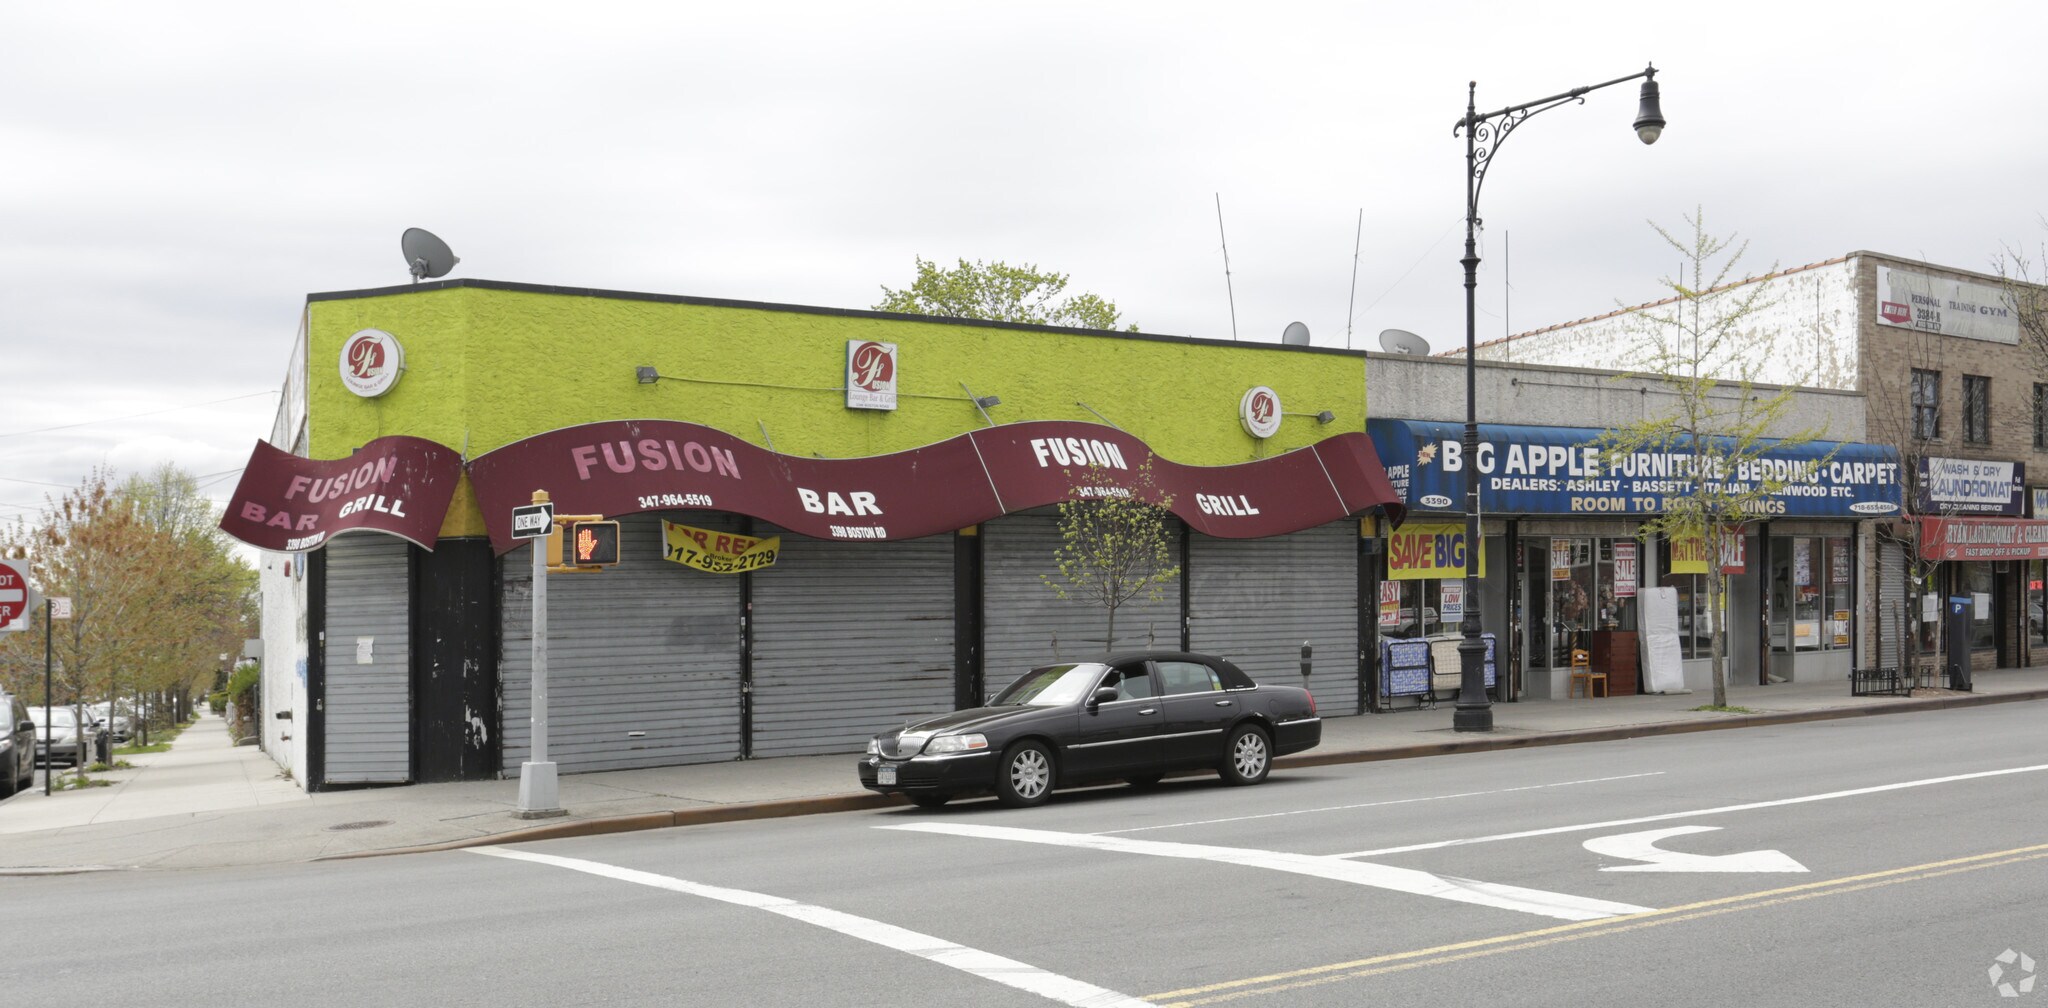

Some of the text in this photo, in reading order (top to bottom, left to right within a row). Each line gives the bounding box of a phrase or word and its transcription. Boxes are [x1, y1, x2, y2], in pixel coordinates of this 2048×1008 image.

[1912, 294, 1941, 307] PERSONAL
[1949, 300, 2008, 318] TRAINING GYM
[571, 439, 742, 480] FUSION
[1030, 437, 1129, 471] FUSION
[1443, 440, 1600, 478] BG APPLE
[1387, 464, 1410, 479] APPLE
[1610, 452, 1724, 479] FURNITURE
[1830, 461, 1897, 485] CARPET
[1943, 464, 2001, 477] WASH & DRY
[285, 456, 398, 504] FUSION
[1491, 477, 1561, 492] DEALERS:
[1566, 479, 1620, 492] ASHLEY
[1632, 480, 1691, 493] BASSETT
[1762, 484, 1827, 497] ENWOOD
[1831, 486, 1855, 498] ETC.
[1931, 479, 2012, 499] LAUNDROMAT
[338, 494, 406, 518] GRILL
[638, 493, 713, 509] 347-964-5519
[797, 487, 883, 516] BAR
[1195, 493, 1260, 517] GRILL
[1425, 497, 1448, 505] 3390
[1571, 496, 1626, 512] ROOM
[1632, 496, 1656, 512] TO
[240, 501, 319, 531] BAR
[517, 514, 541, 529] ONE WAY
[845, 526, 876, 539] BOSTON
[874, 526, 887, 539] RD
[1946, 524, 1967, 544] RYAN
[1968, 524, 2017, 545] LAUNDROMAT
[1390, 533, 1465, 570] SAVE BIG
[1552, 550, 1569, 568] SALE
[1671, 536, 1708, 562] MATTRE
[1965, 547, 1979, 556] FAST
[1979, 547, 1994, 556] DROP
[1994, 548, 2006, 556] OFF
[2011, 547, 2031, 556] PICKUP
[1615, 559, 1635, 581] SALE
[1443, 603, 1461, 611] PRICES
[1444, 594, 1460, 603] LOW
